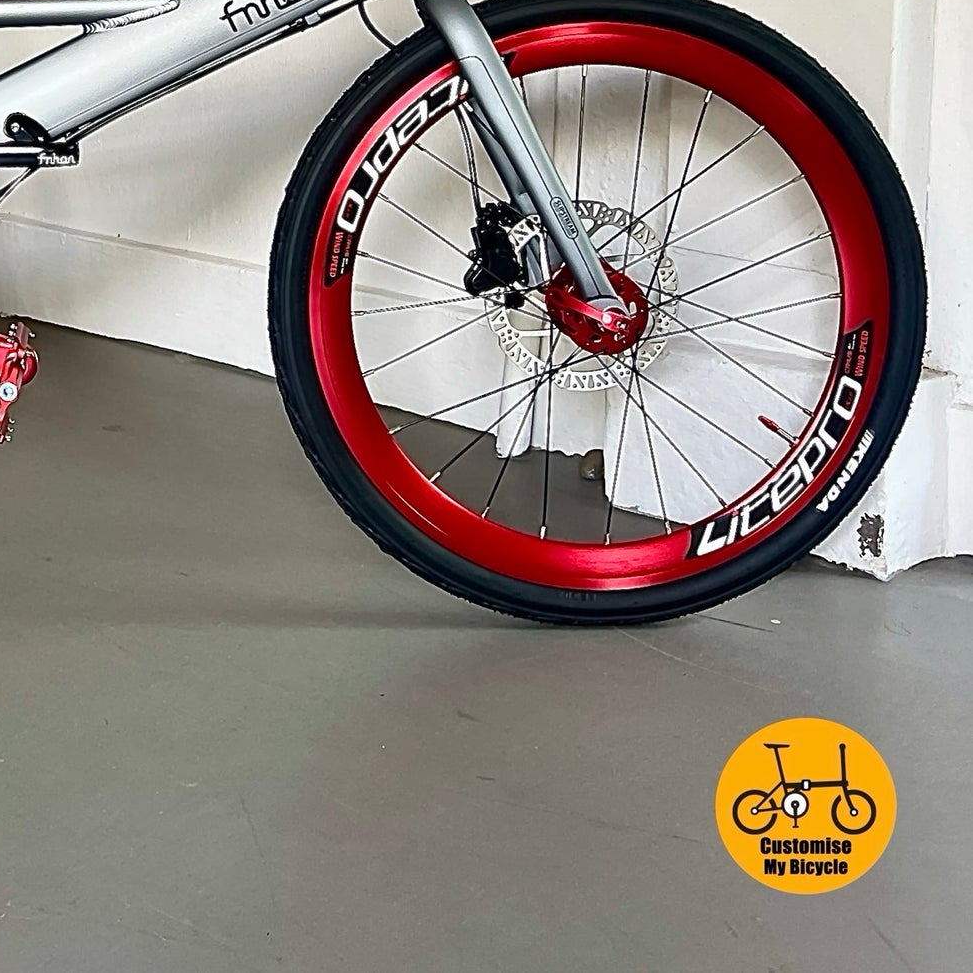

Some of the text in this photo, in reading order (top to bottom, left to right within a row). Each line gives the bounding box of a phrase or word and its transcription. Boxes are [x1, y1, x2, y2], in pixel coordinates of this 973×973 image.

[37, 152, 76, 165] fnhon
[336, 75, 470, 233] itepro
[815, 443, 870, 513] KENDA
